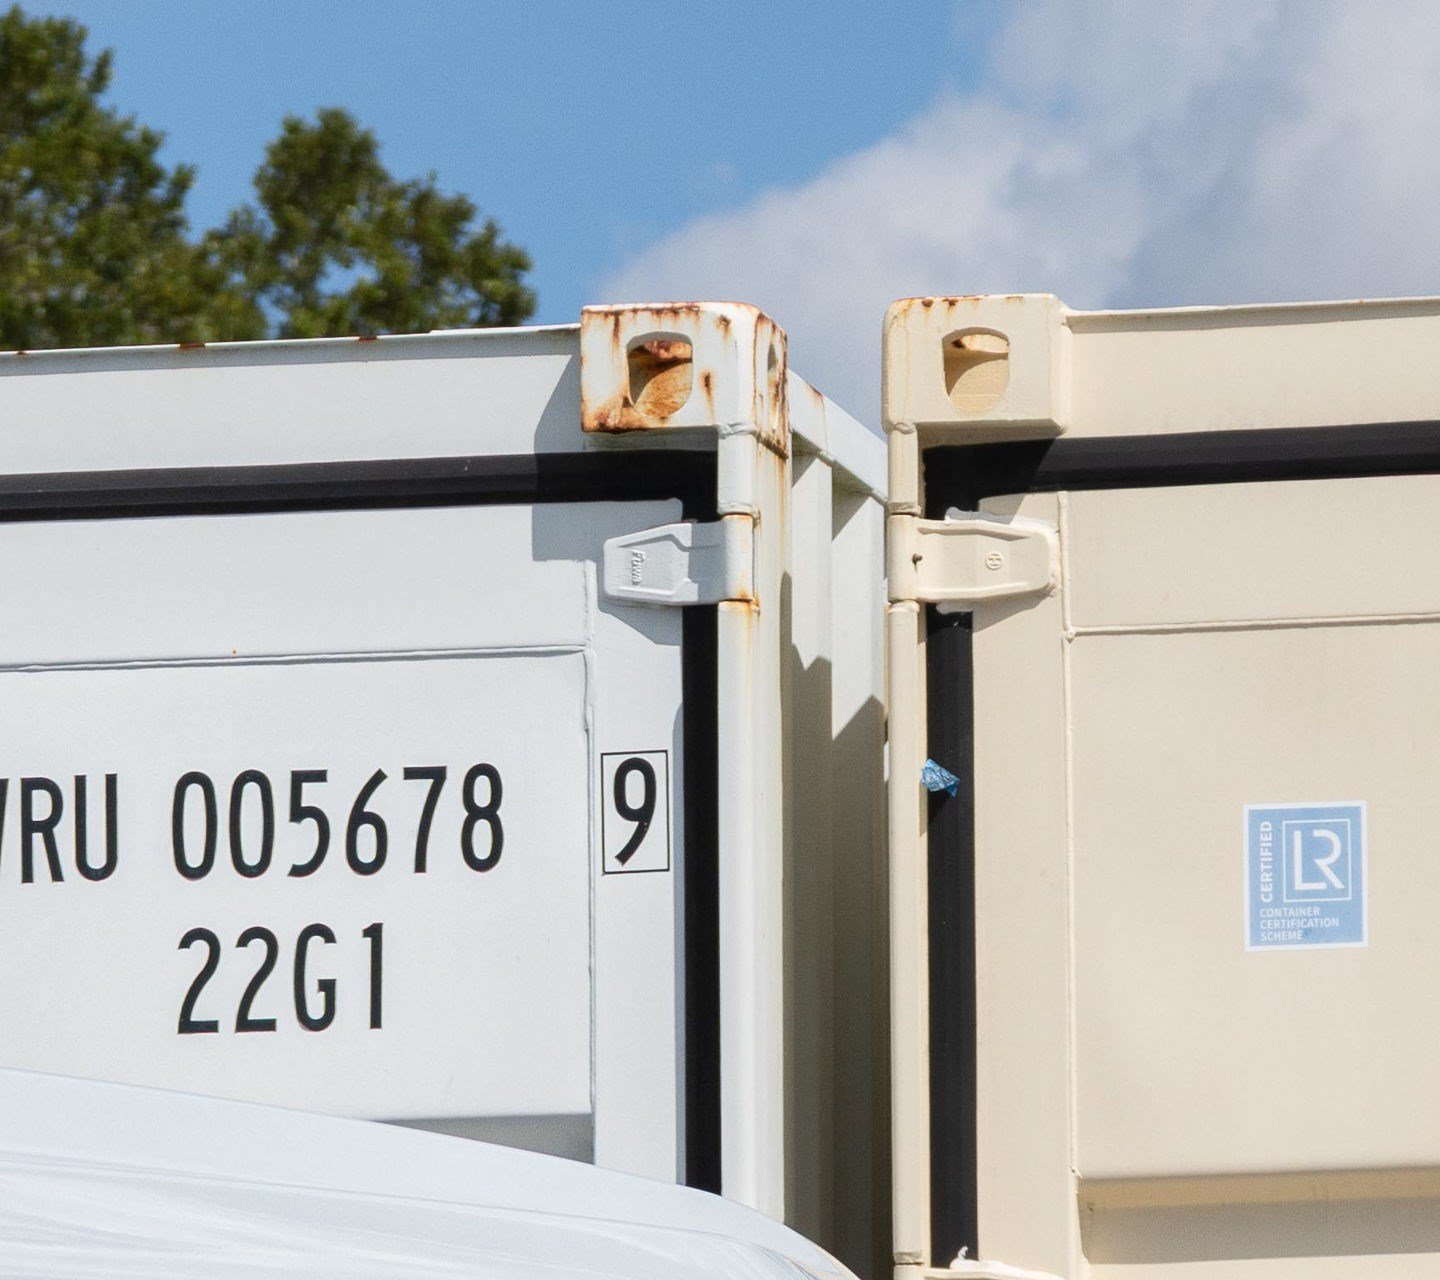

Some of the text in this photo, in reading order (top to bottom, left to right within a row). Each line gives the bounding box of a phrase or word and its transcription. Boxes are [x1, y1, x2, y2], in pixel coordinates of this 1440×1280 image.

[171, 762, 505, 881] 005678
[611, 757, 659, 867] 9
[1260, 821, 1272, 903] CERTIFIED
[1293, 829, 1345, 891] LR
[1260, 907, 1320, 918] CONTAINER
[1260, 917, 1339, 930] CERTIFICATION
[1260, 930, 1304, 942] SCHEME
[177, 922, 384, 1035] 22G1
